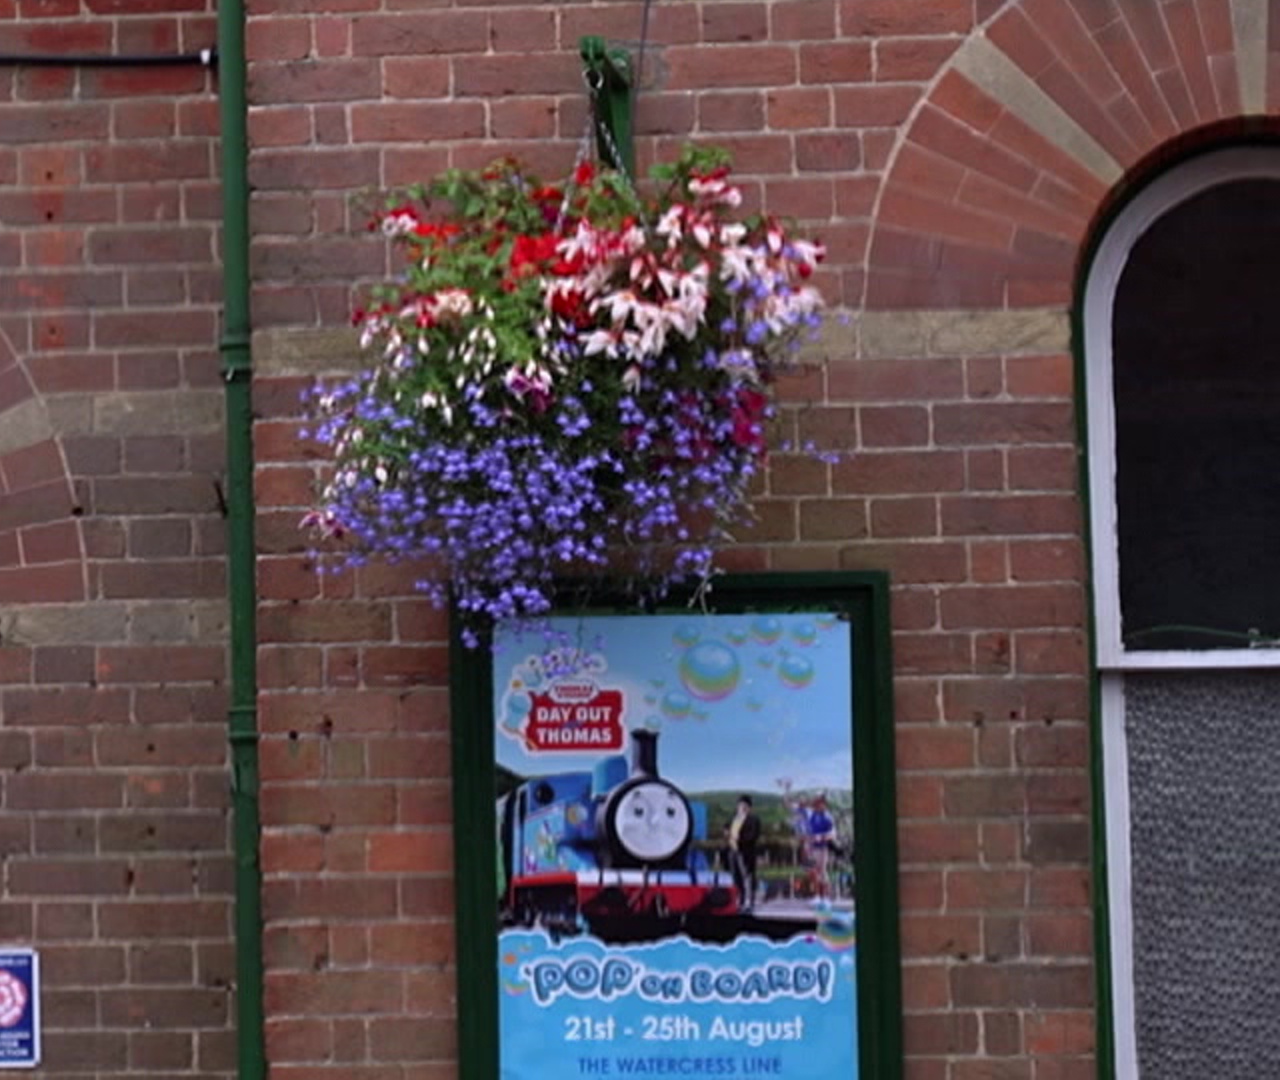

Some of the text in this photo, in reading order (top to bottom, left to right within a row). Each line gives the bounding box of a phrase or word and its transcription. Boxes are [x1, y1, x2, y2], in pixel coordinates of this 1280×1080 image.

[537, 706, 612, 723] DAY OUT
[537, 727, 612, 745] THOMAS
[690, 961, 832, 999] BOARD!
[564, 1016, 615, 1042] 21st
[642, 1015, 699, 1042] 25th
[708, 1015, 804, 1047] August
[578, 1057, 783, 1075] THE WATERCRESS LINE
